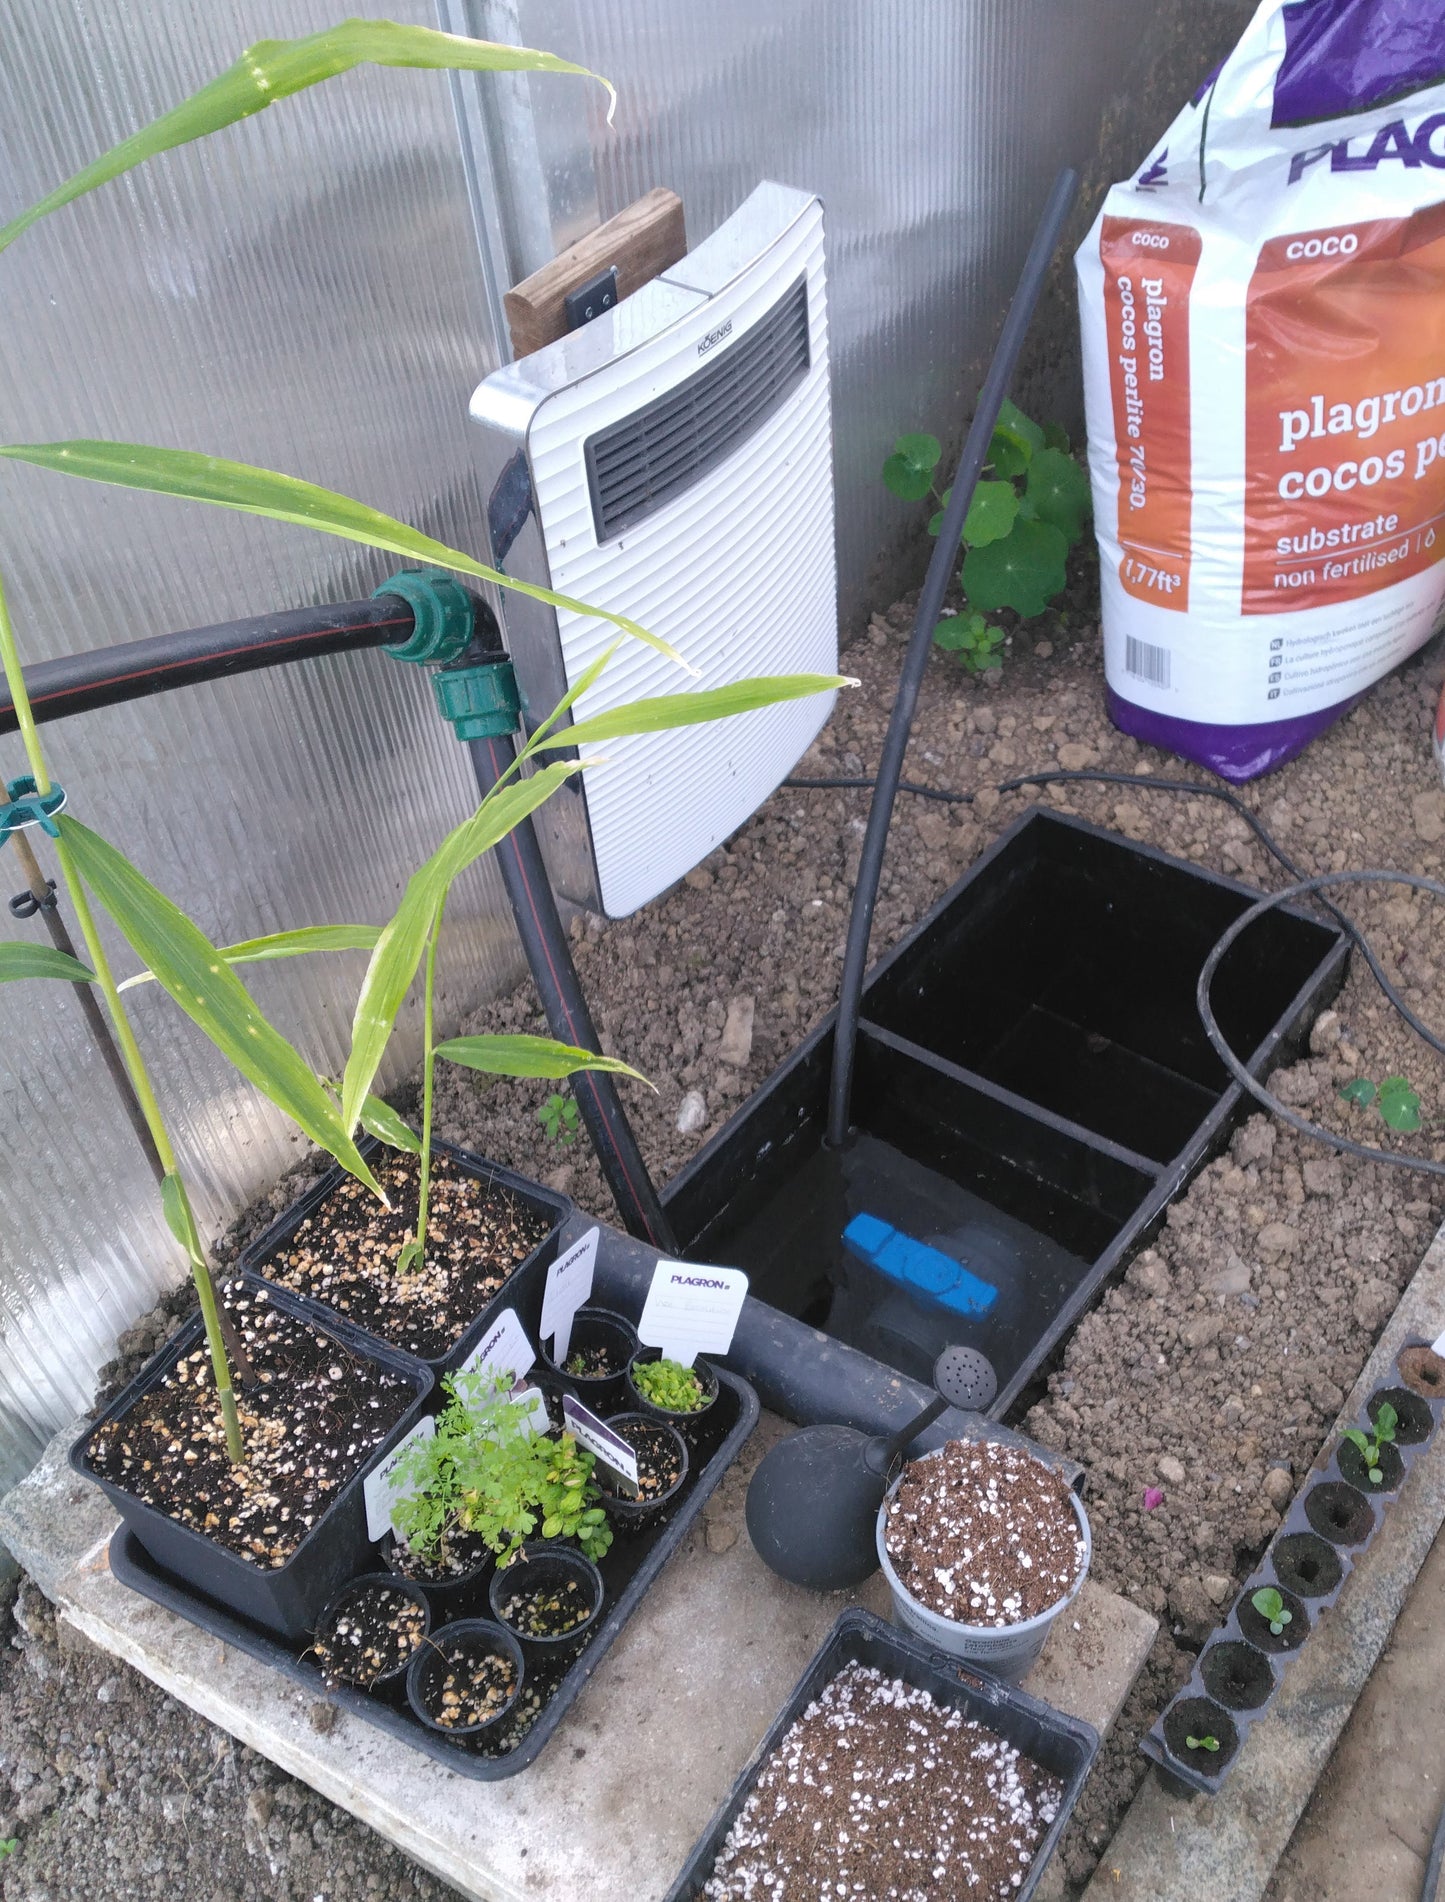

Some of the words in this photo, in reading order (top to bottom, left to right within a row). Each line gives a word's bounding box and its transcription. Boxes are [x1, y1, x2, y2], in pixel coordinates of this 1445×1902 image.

[1132, 231, 1170, 250] COCO
[1286, 233, 1358, 260] COCO
[1118, 276, 1136, 351] cocos
[1142, 277, 1168, 381] plagron
[1120, 355, 1144, 438] perlite
[1278, 376, 1445, 453] plagron
[1278, 449, 1406, 500] cocos
[1276, 514, 1399, 555] substrate
[1274, 569, 1316, 588] non
[1322, 538, 1410, 580] fertilised
[671, 1275, 724, 1290] PLAGRON
[571, 1420, 625, 1471] PLAGRON
